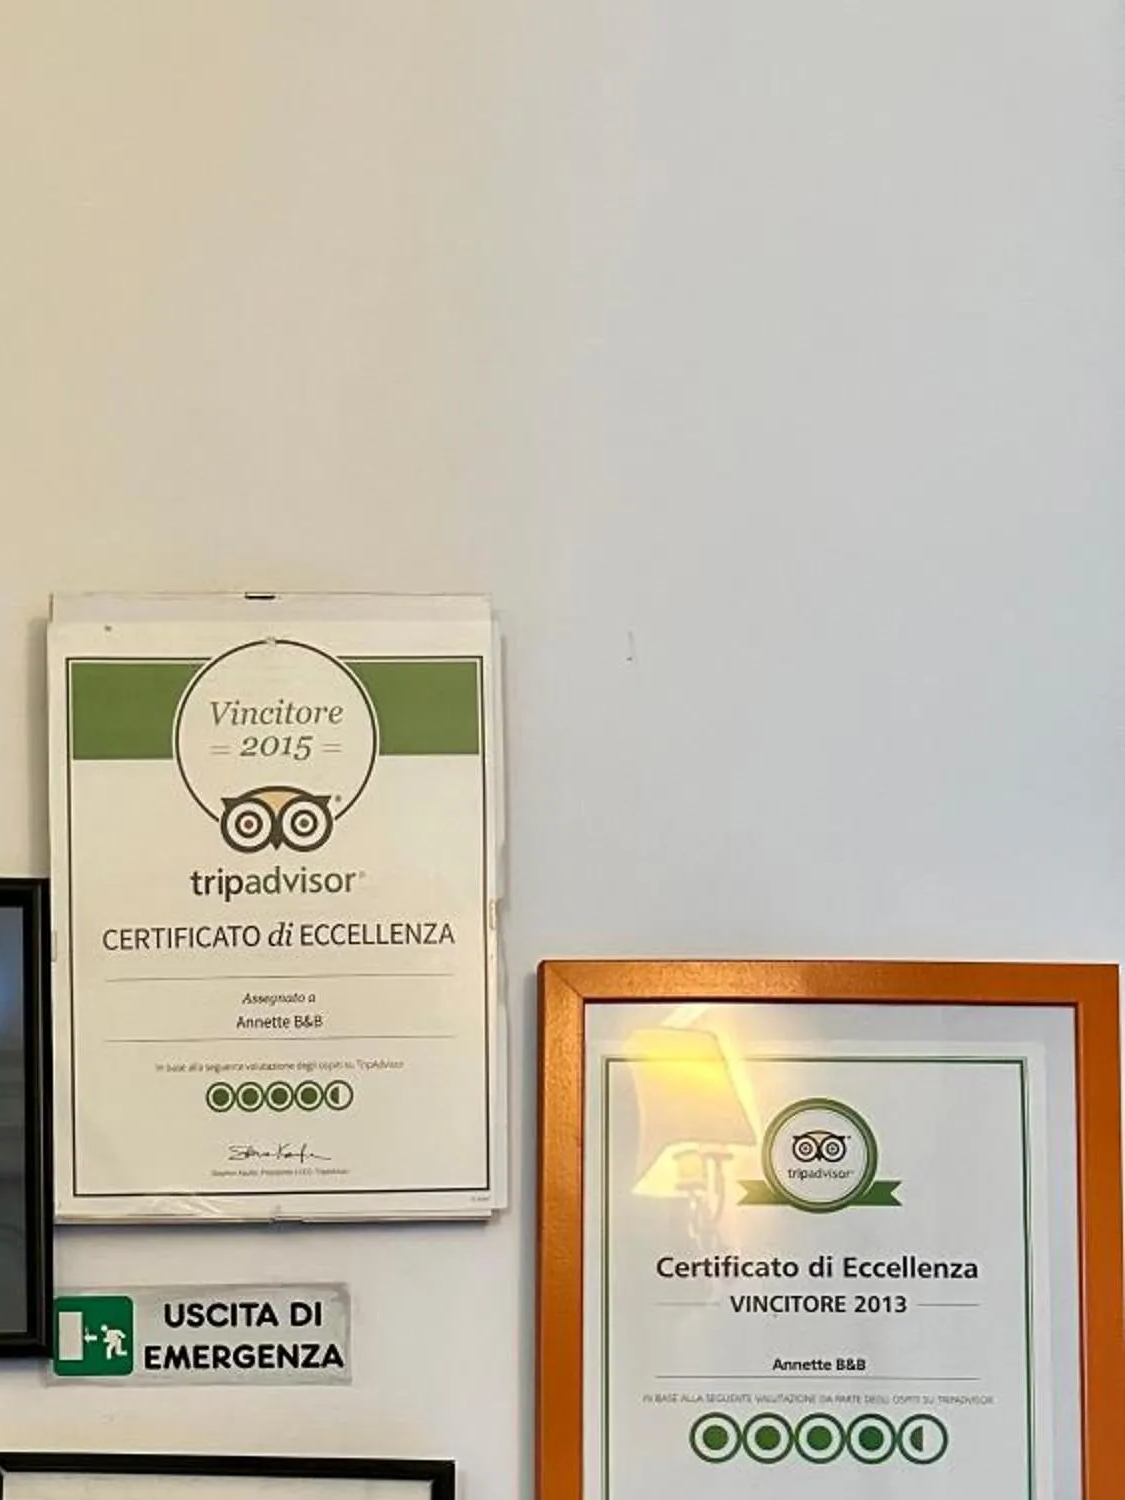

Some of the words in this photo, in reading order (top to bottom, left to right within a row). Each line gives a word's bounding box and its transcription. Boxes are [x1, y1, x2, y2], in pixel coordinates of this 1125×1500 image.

[210, 700, 344, 725] Vincitore
[240, 736, 313, 760] 2015
[190, 867, 356, 902] tripadvisor
[102, 925, 261, 951] CERTIFICATO
[268, 924, 294, 948] di
[300, 923, 455, 947] ECCELLENZA
[242, 992, 305, 1006] Assegnato
[309, 994, 316, 1003] a
[236, 1015, 290, 1029] Annette
[294, 1015, 323, 1028] B&B
[787, 1168, 851, 1181] tripadvisor
[656, 1256, 799, 1279] Certificato
[808, 1256, 833, 1279] di
[843, 1256, 979, 1280] Eccellenza
[164, 1302, 278, 1327] USCITA
[291, 1302, 322, 1326] DI
[730, 1295, 847, 1314] VINCITORE
[854, 1296, 907, 1313] 2013
[144, 1344, 344, 1370] EMERGENZA
[773, 1358, 832, 1371] Annette
[836, 1358, 866, 1371] B&B
